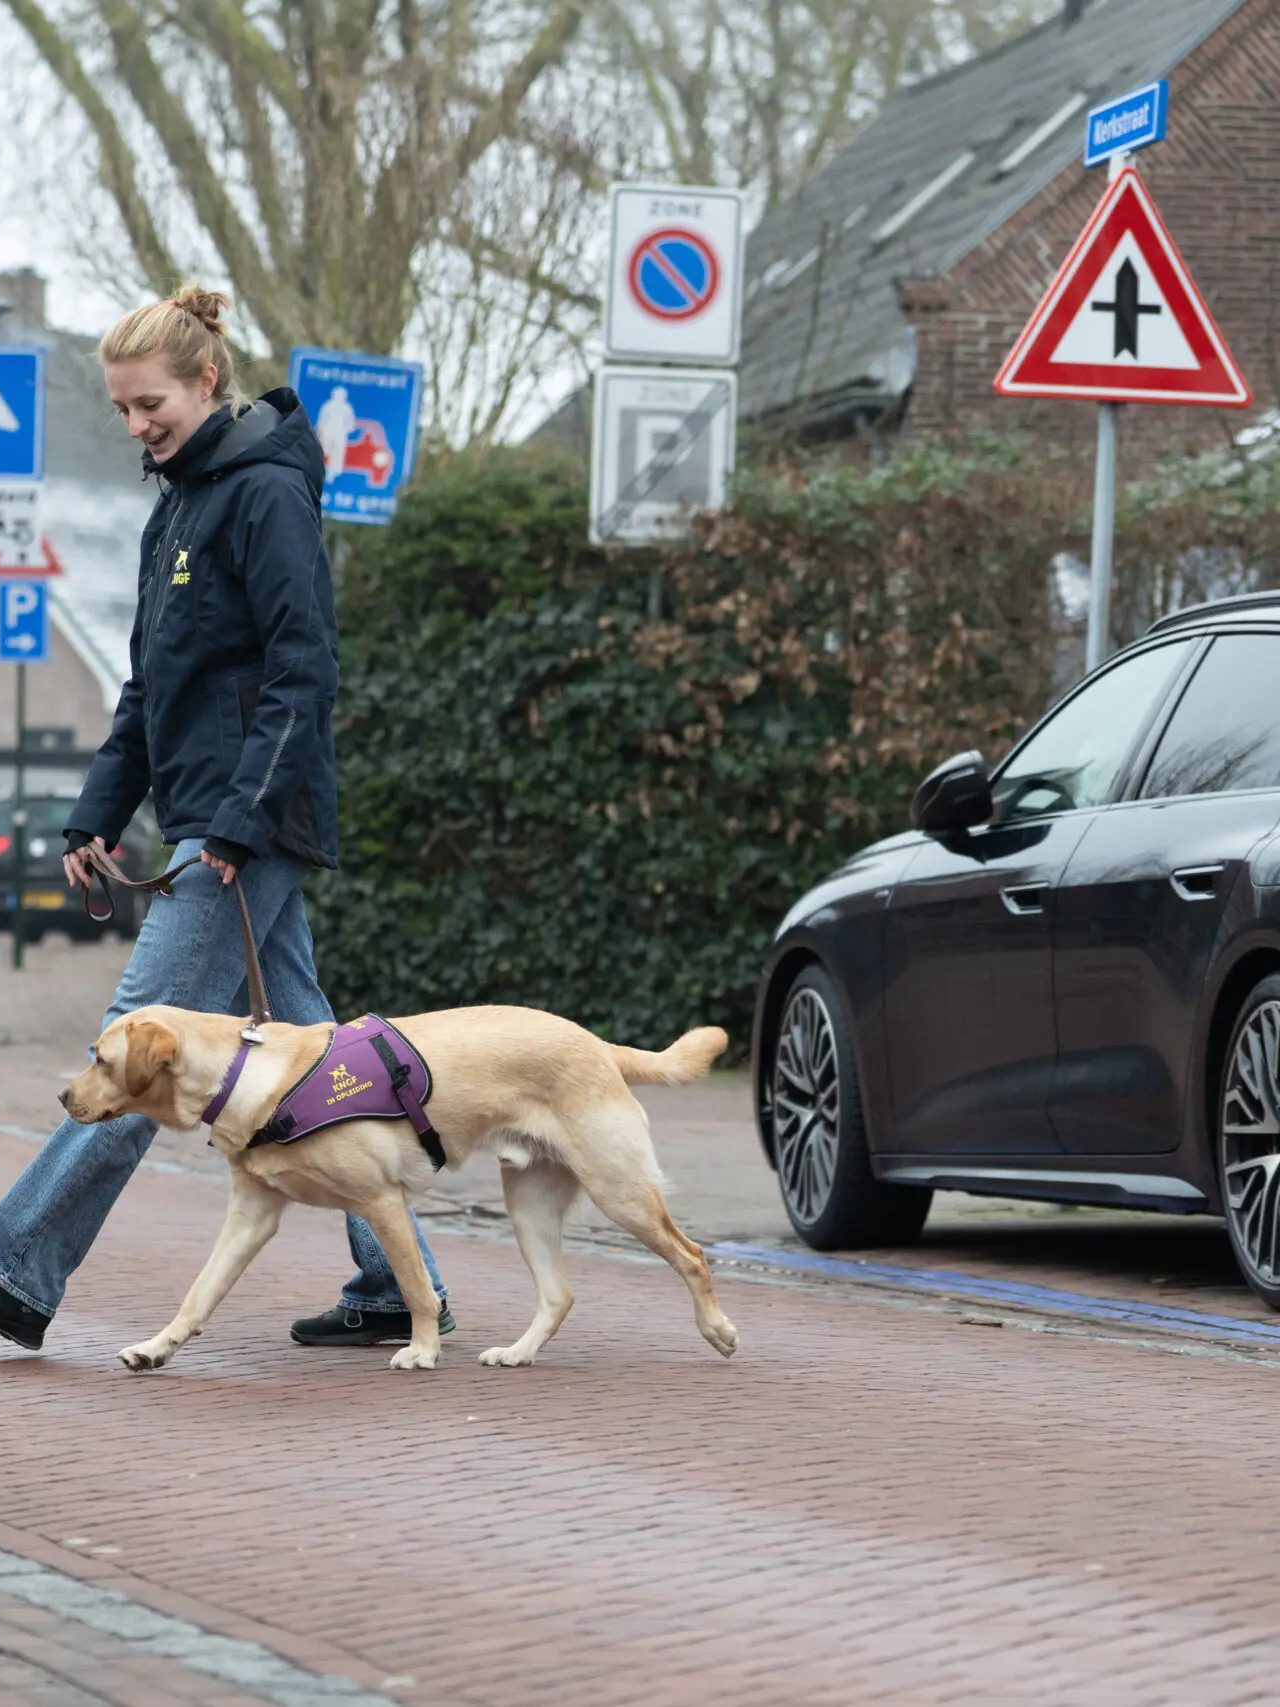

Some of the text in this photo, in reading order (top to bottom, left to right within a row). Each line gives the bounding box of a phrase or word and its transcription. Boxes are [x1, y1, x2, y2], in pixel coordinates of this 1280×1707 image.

[1093, 101, 1150, 146] Kerkstraat
[649, 200, 704, 218] ZONE
[6, 585, 39, 628] P
[326, 1080, 373, 1106] IN OPLEIDING
[332, 1075, 357, 1093] KNGF
